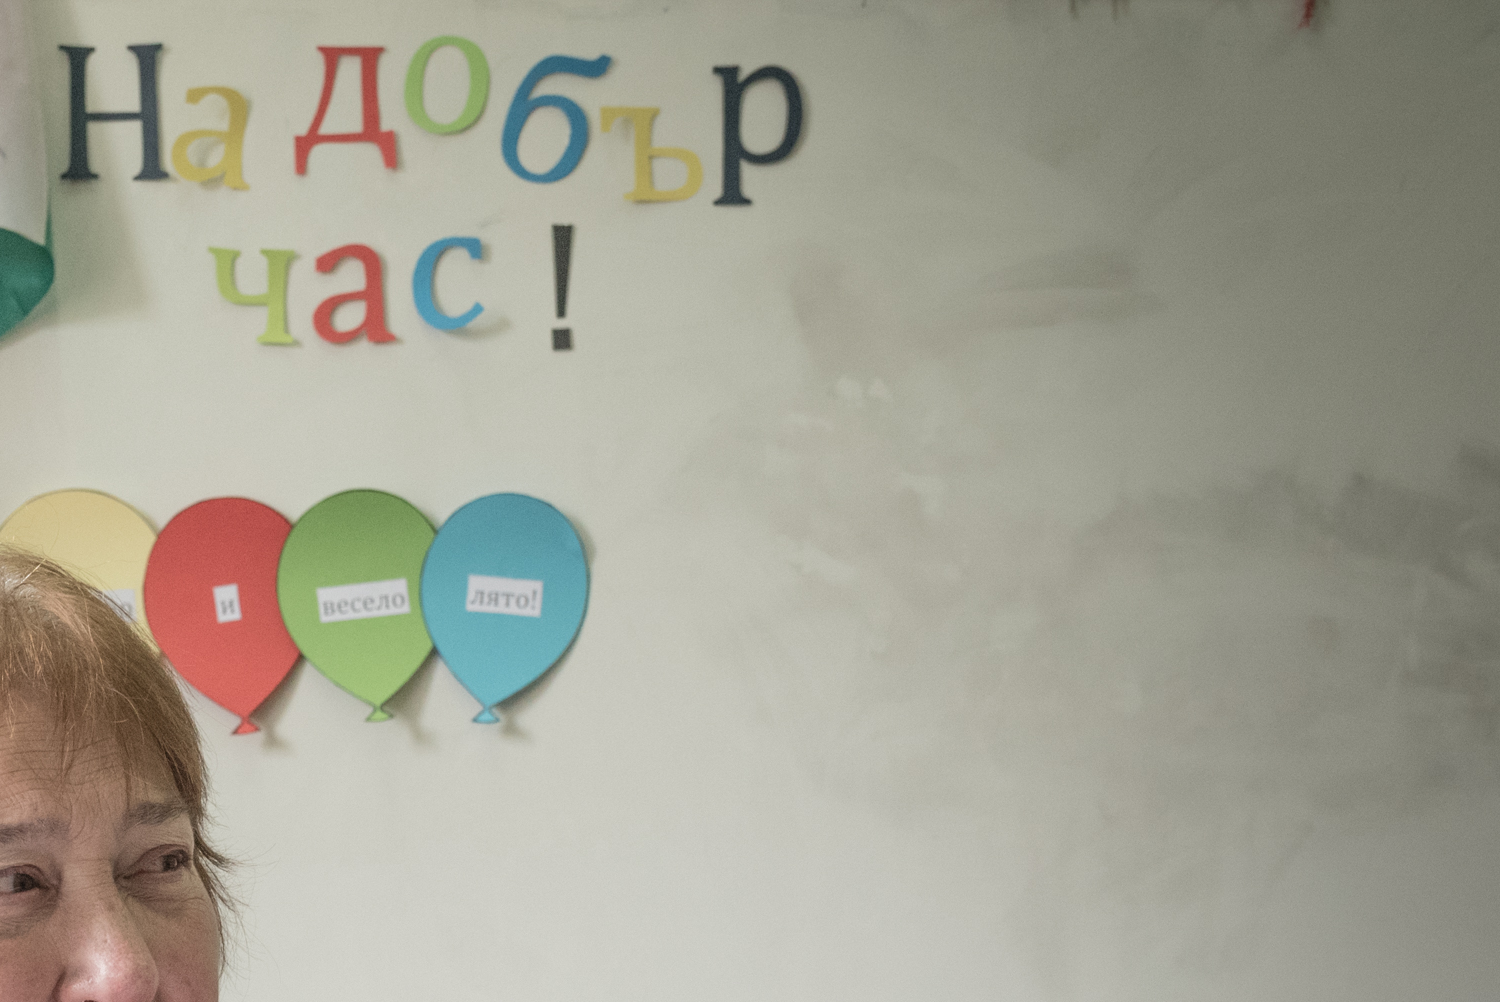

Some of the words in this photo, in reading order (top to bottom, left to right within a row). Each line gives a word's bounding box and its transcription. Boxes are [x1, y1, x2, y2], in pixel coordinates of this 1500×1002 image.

[57, 43, 250, 191] На
[294, 35, 804, 205] добър
[208, 235, 485, 346] час
[552, 224, 575, 351] !
[220, 598, 236, 615] и
[321, 591, 407, 617] весело
[469, 589, 538, 611] лято!
